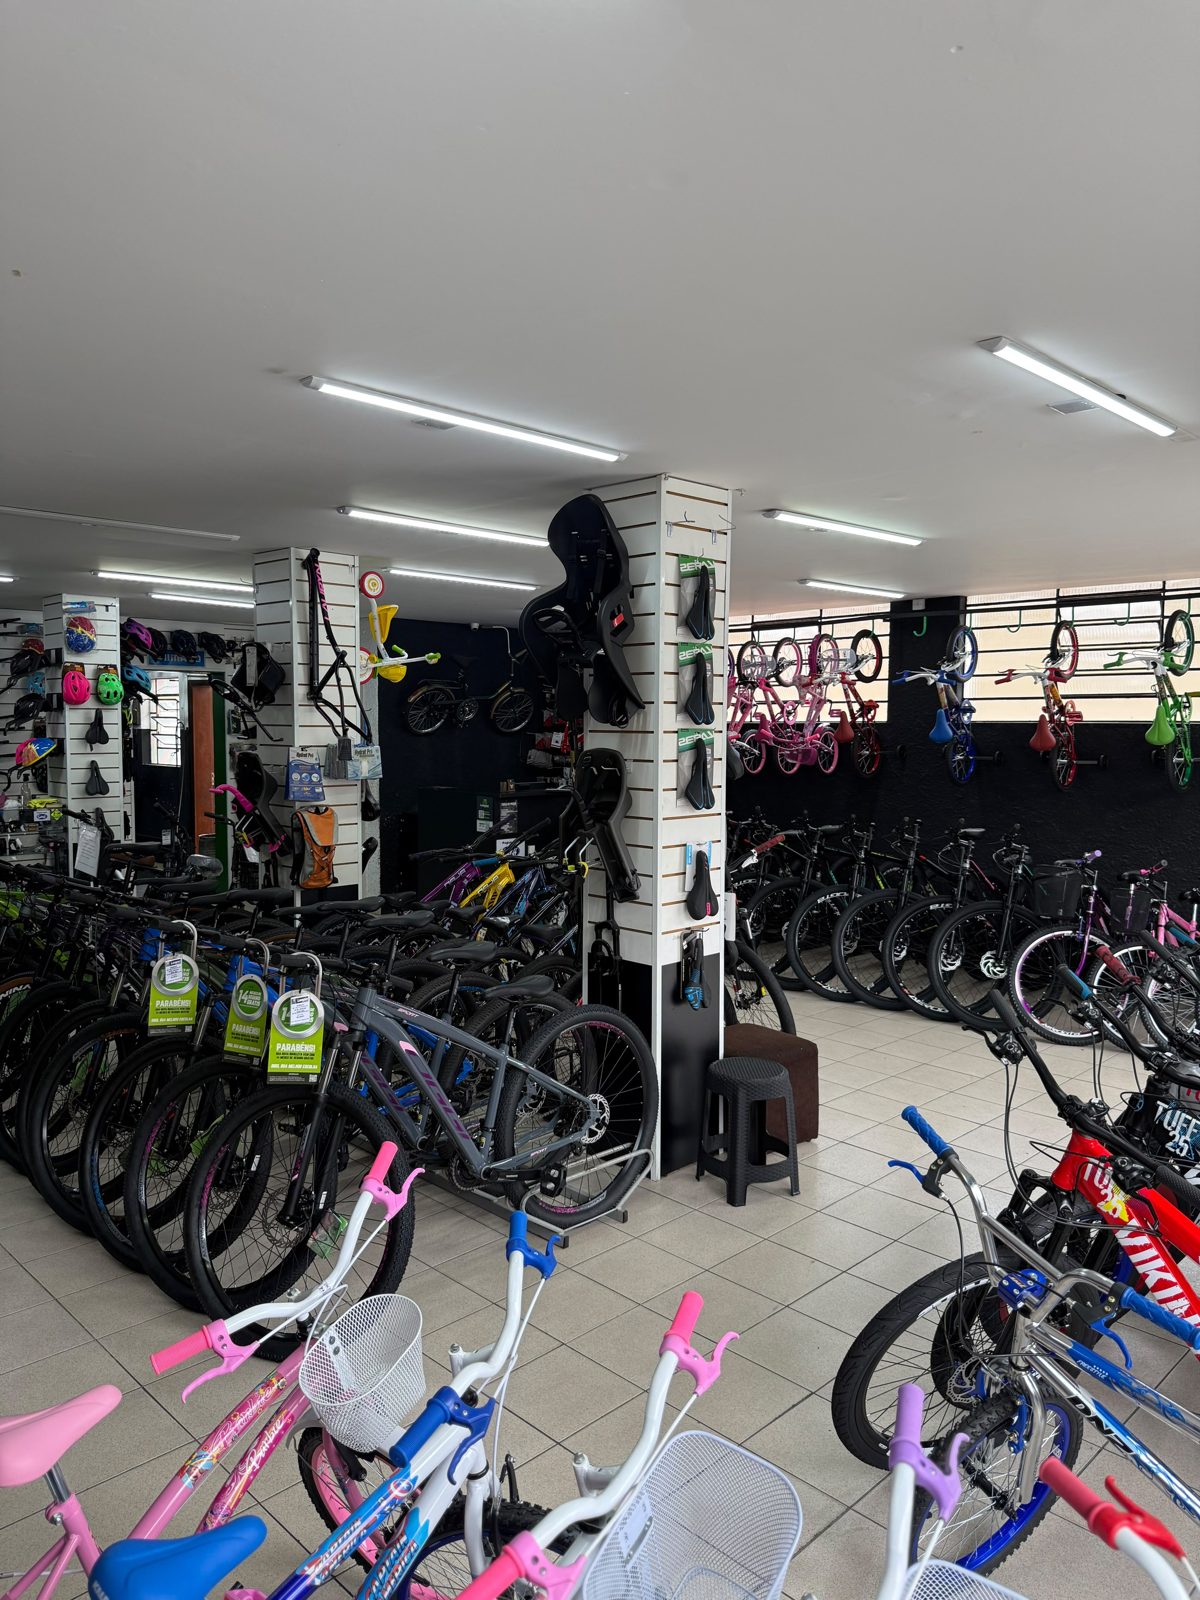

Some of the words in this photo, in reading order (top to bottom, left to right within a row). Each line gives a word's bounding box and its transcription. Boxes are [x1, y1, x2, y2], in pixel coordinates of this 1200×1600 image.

[238, 990, 249, 1003] 14
[397, 1006, 420, 1018] SPORT
[276, 1042, 316, 1052] PARABÉNS!
[1154, 1100, 1200, 1139] TUFF
[1165, 1130, 1189, 1157] 25
[1076, 1359, 1107, 1379] FREESTYLE
[242, 1418, 283, 1475] Barbie
